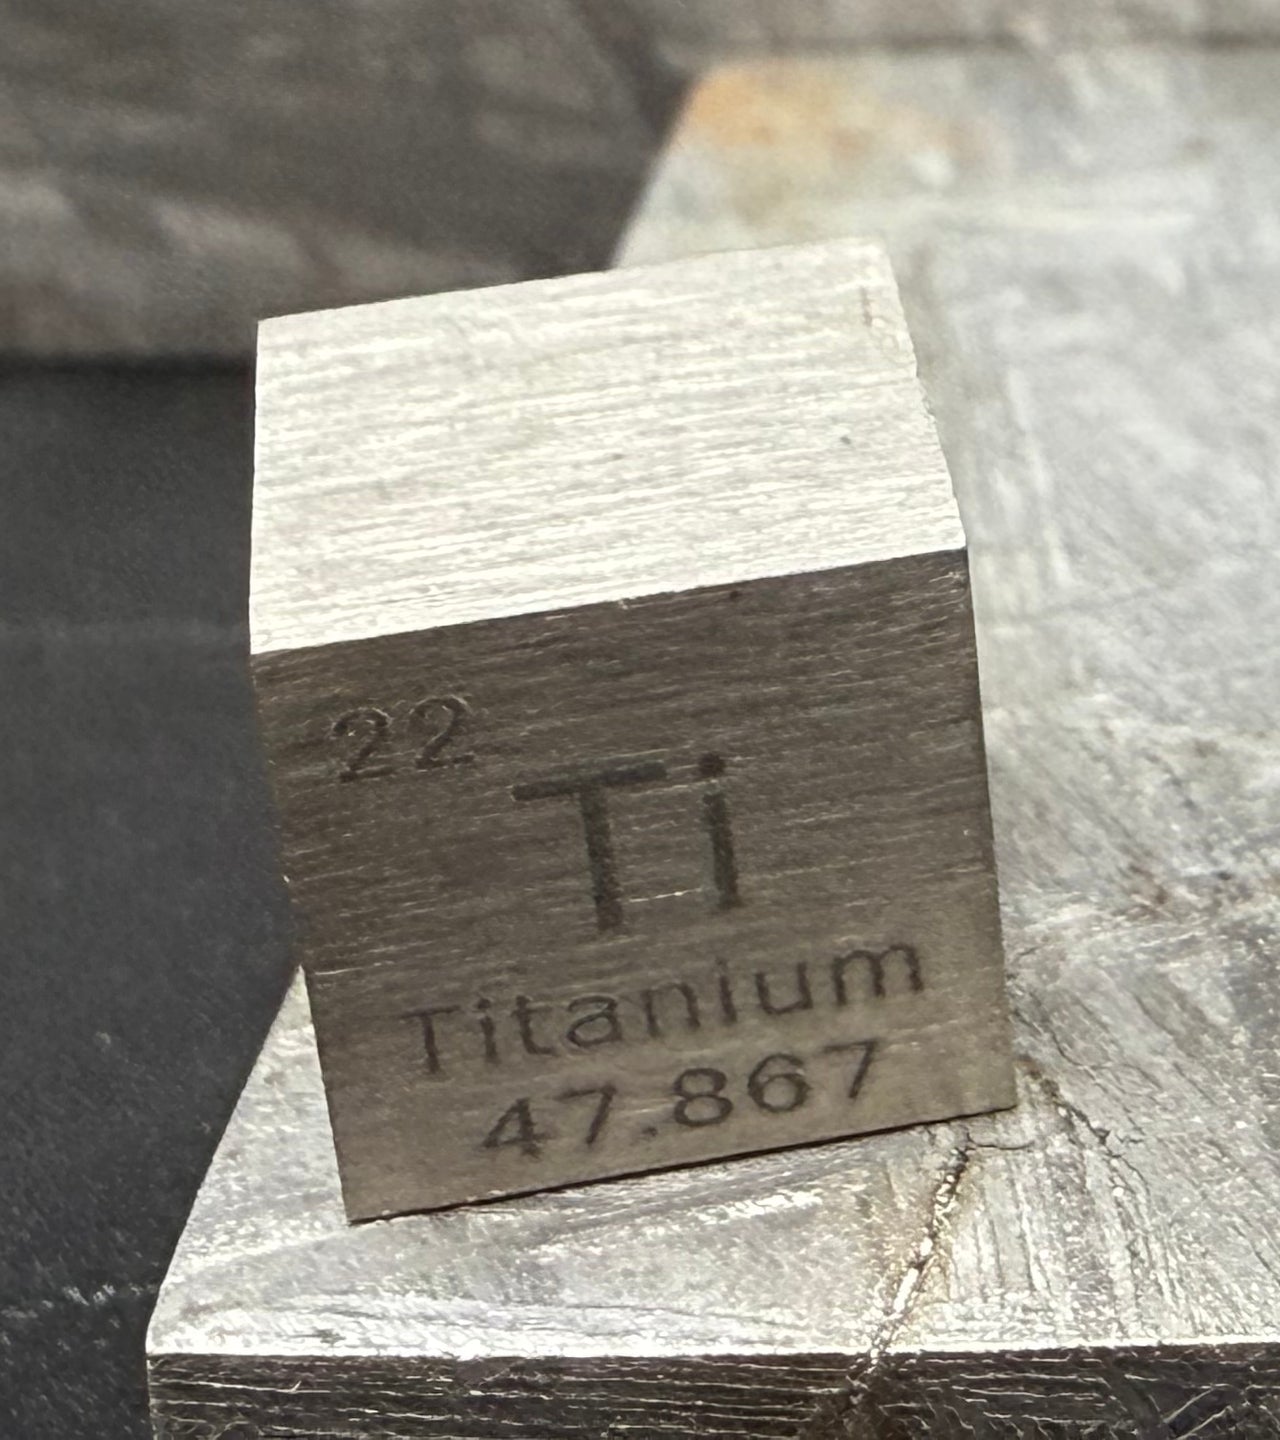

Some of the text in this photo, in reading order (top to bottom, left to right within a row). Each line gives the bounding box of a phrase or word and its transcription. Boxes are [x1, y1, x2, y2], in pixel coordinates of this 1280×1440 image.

[331, 694, 476, 783] 22
[512, 755, 742, 932] Ti
[402, 940, 926, 1075] Titanium
[482, 1038, 882, 1158] 47.867
